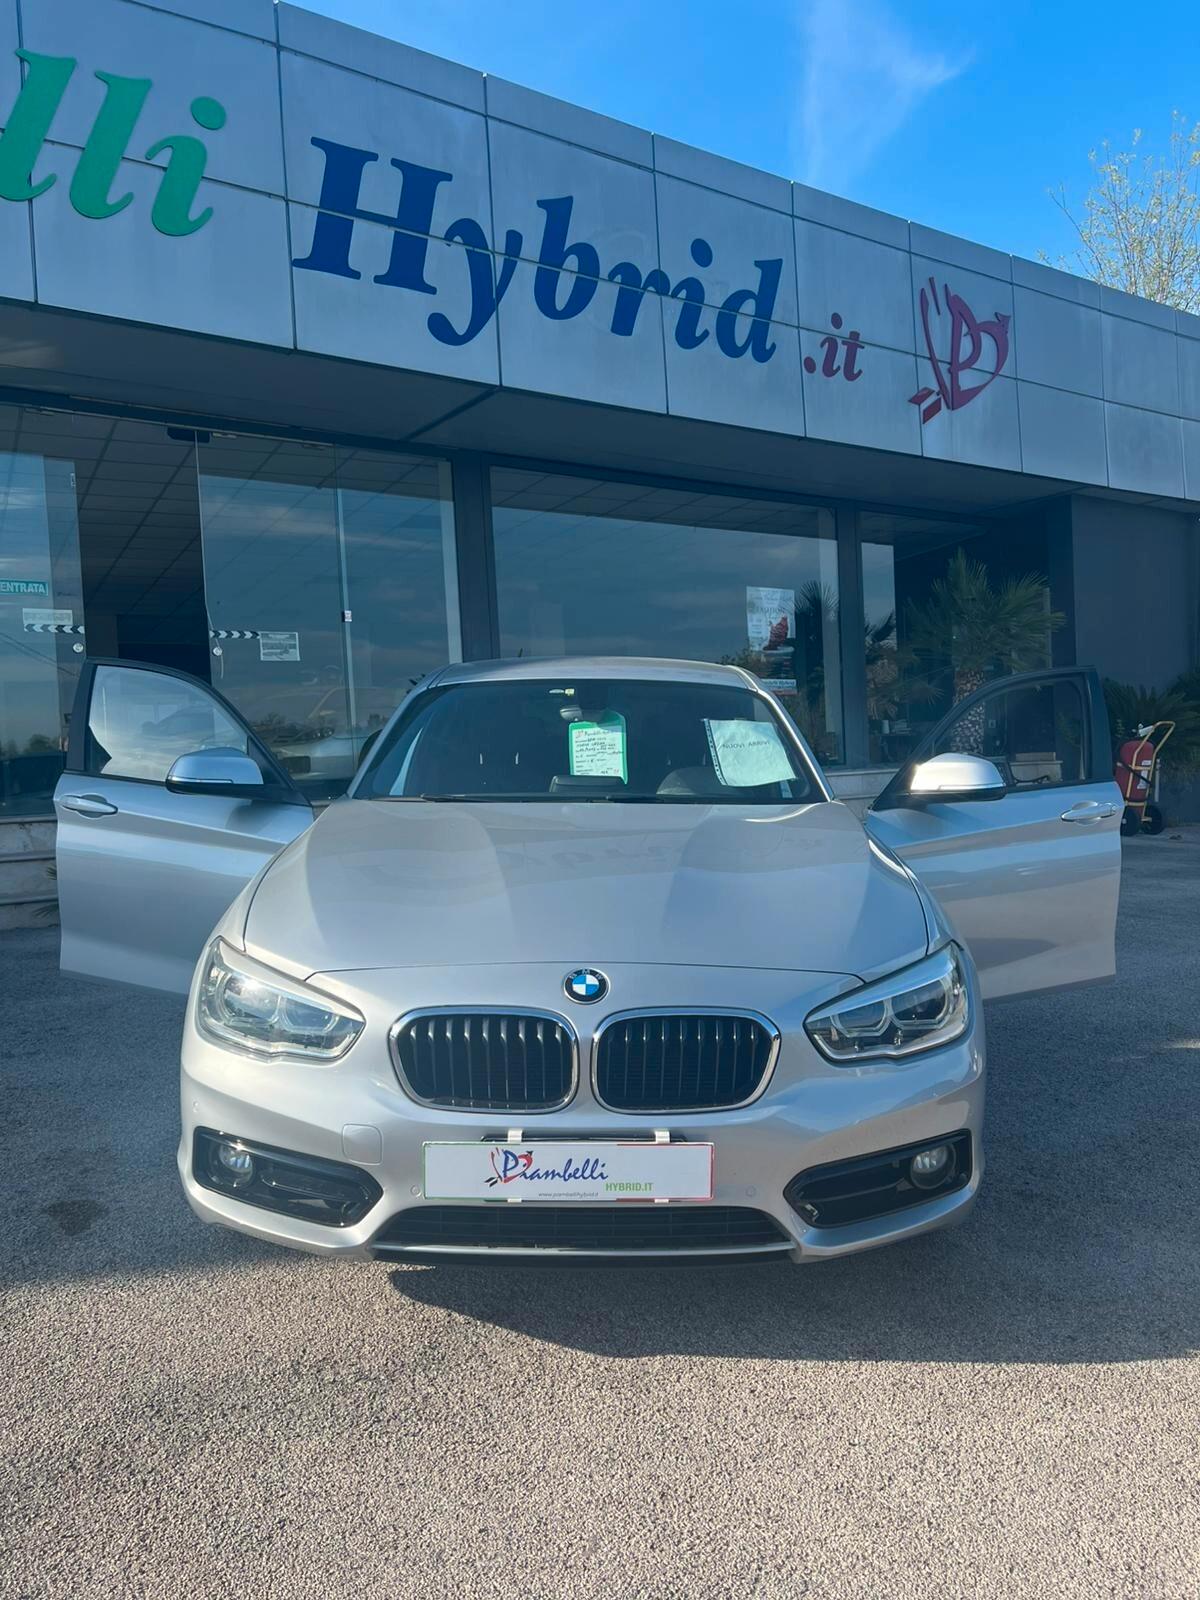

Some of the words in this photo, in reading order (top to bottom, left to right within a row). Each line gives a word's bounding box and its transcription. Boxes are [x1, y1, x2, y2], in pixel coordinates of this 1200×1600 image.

[292, 136, 784, 364] Hybrid
[803, 312, 864, 382] .it
[1, 582, 46, 594] ENTRATA
[569, 968, 604, 980] BMW
[502, 1149, 609, 1182] Piambelli
[605, 1182, 655, 1192] HYBRID.IT
